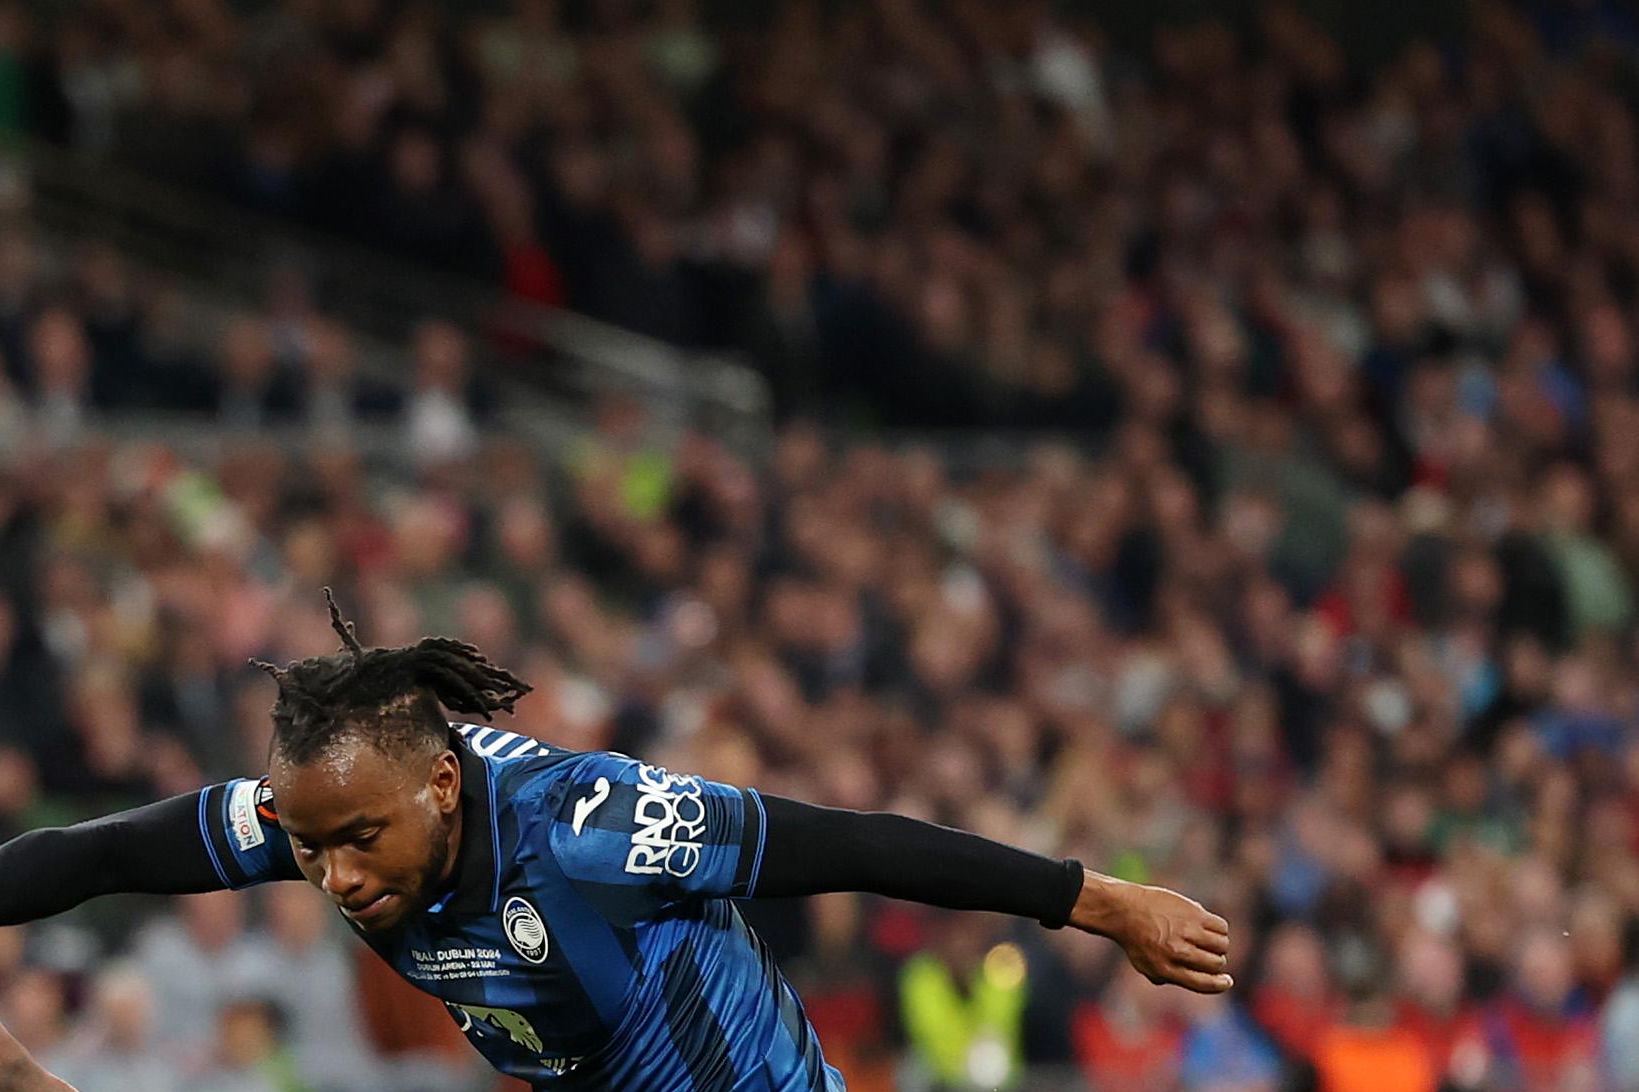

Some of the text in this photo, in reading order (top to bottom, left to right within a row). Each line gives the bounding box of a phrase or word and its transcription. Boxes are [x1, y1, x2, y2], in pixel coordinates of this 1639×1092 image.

[625, 763, 676, 875] RADIC
[665, 774, 706, 878] GROU
[437, 948, 475, 960] DUBLIN
[477, 948, 501, 960] 2024
